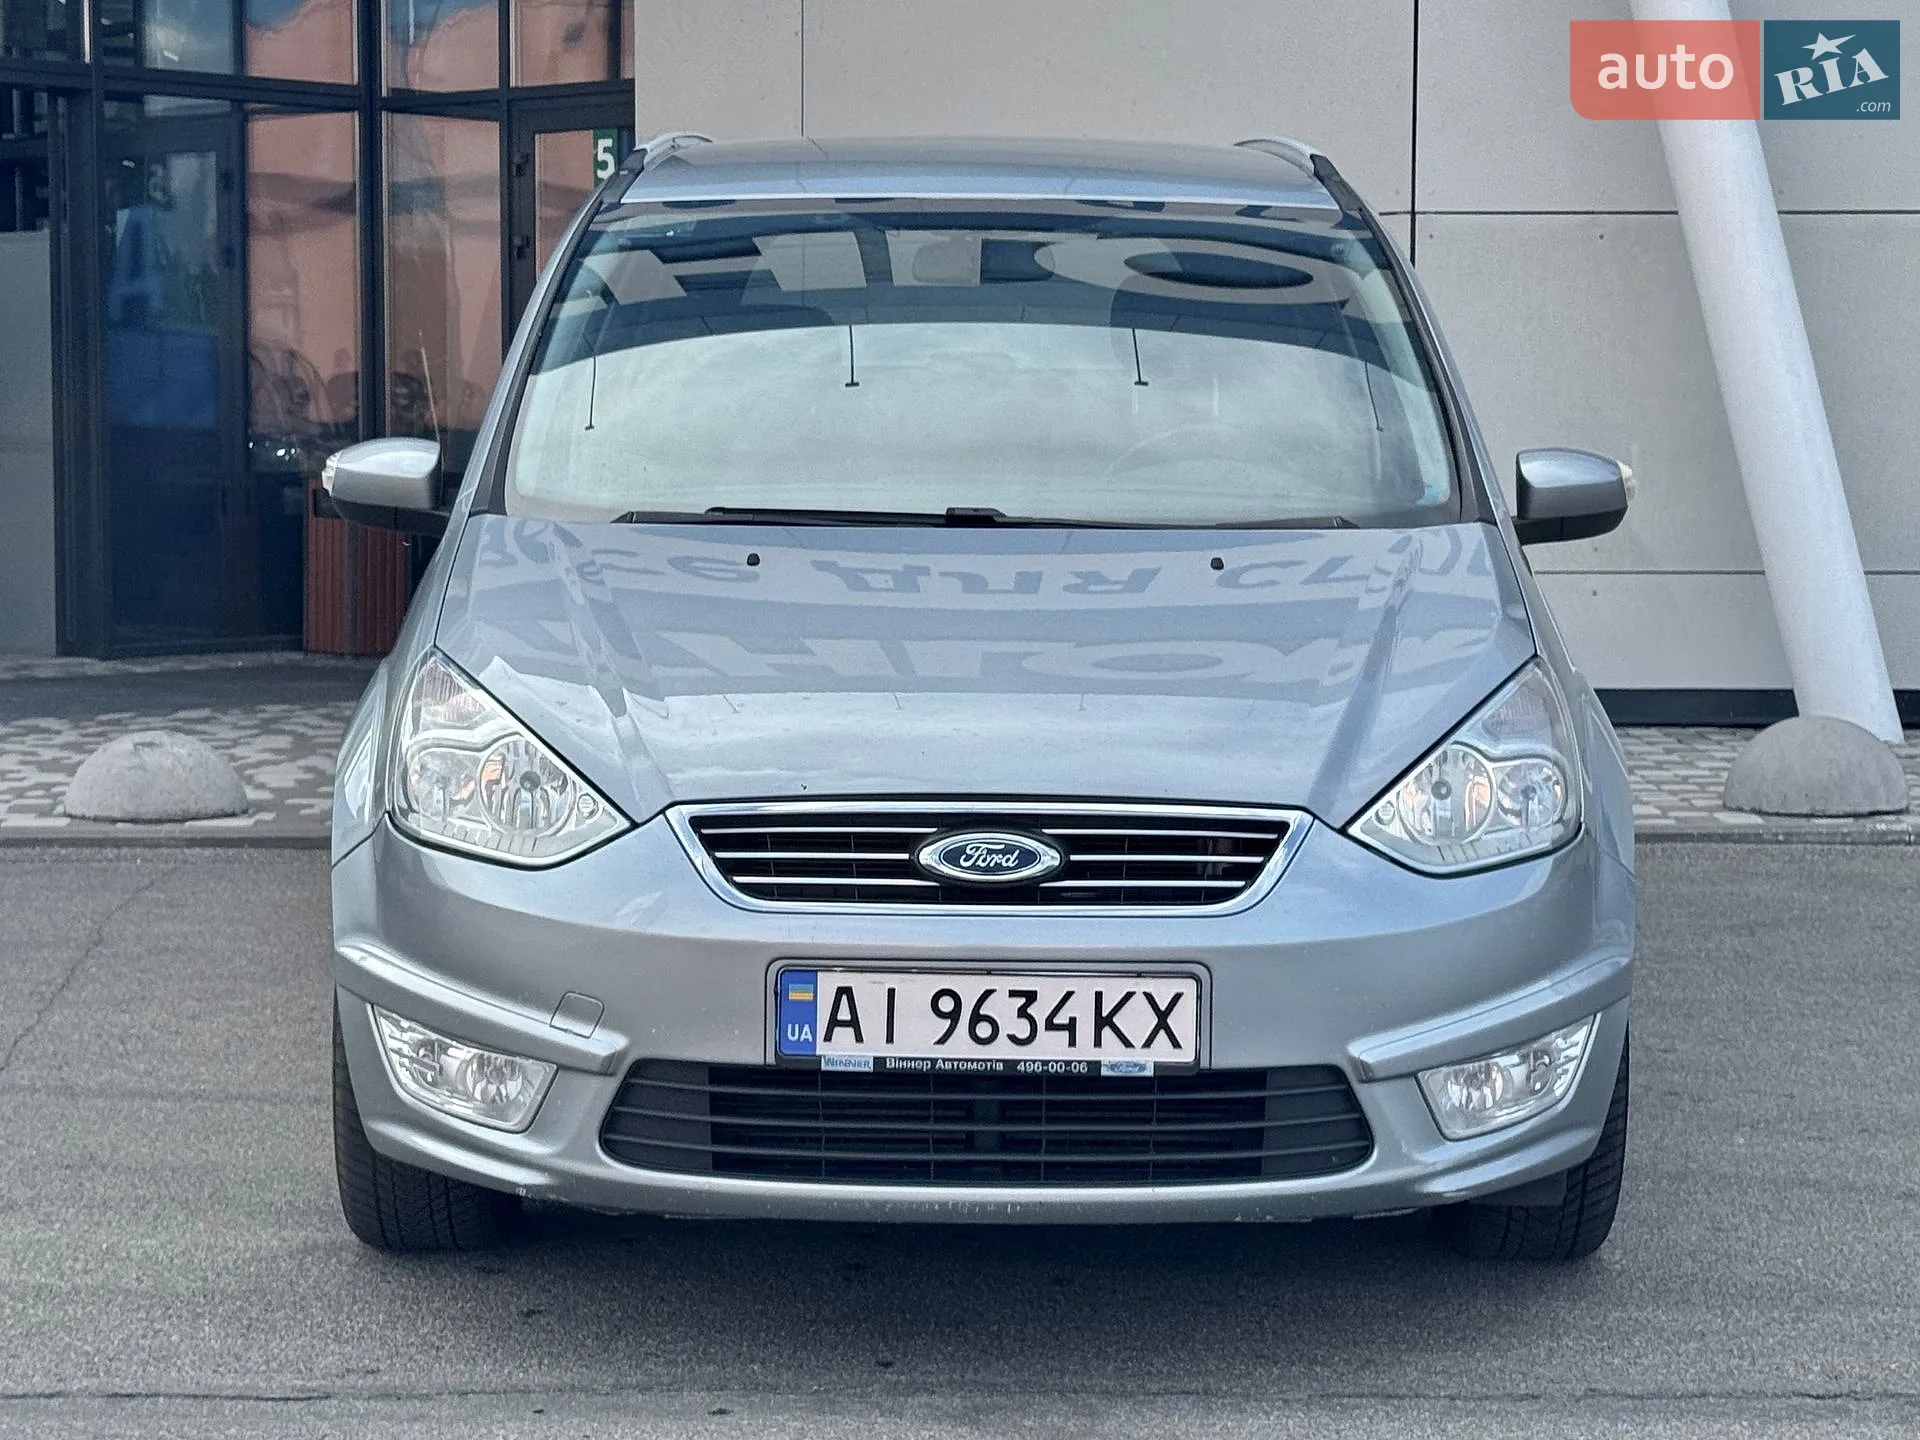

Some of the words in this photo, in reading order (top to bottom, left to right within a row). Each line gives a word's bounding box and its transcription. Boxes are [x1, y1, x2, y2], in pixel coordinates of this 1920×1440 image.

[596, 138, 616, 179] 5
[959, 843, 1019, 867] Ford
[787, 1023, 813, 1042] UA
[930, 988, 1077, 1047] 9634
[1093, 990, 1184, 1049] KX
